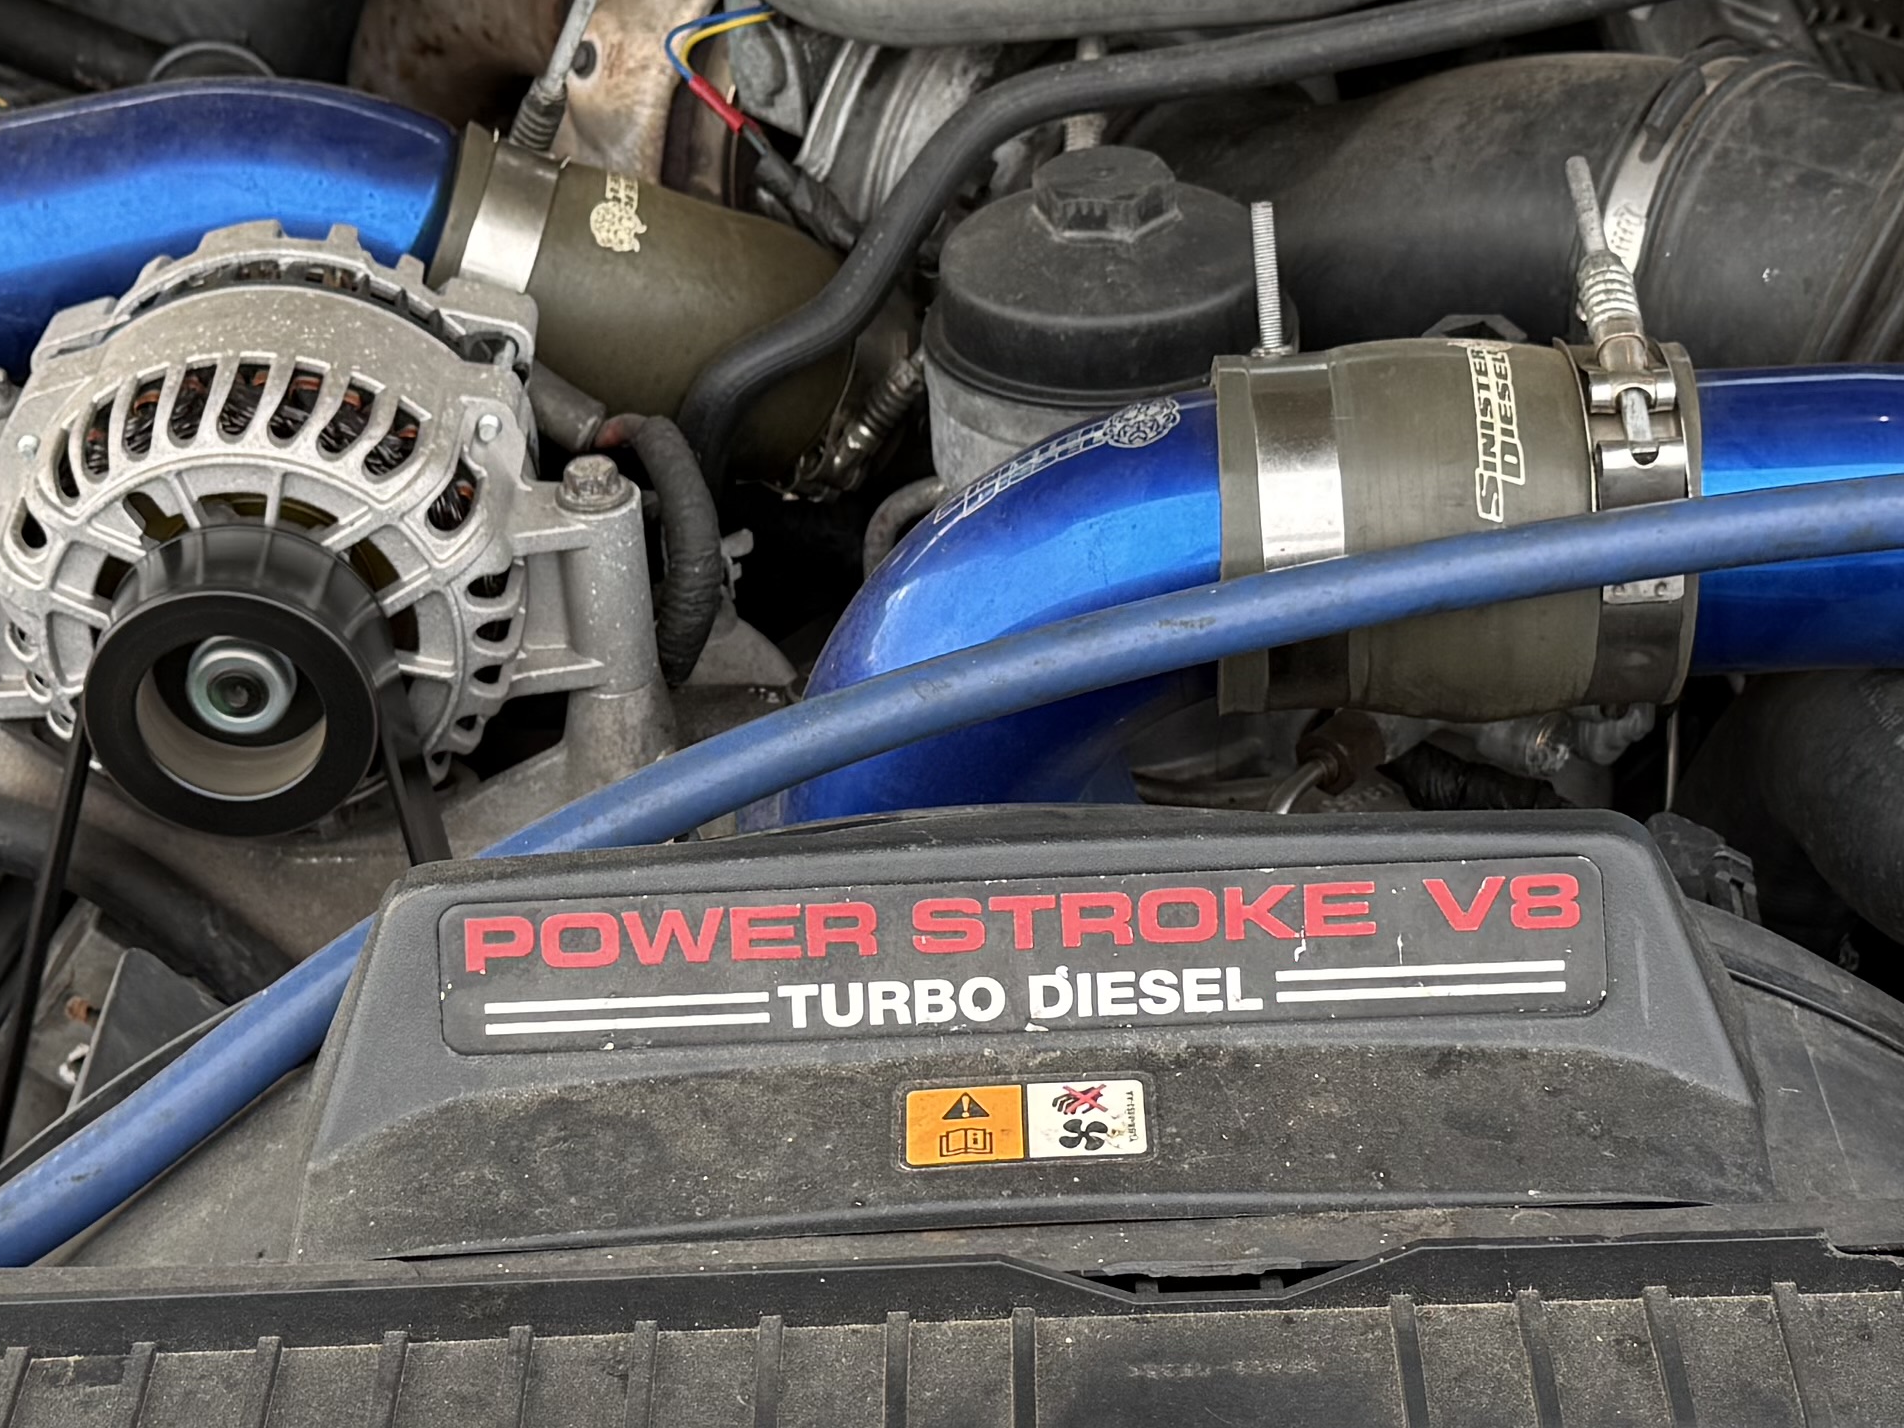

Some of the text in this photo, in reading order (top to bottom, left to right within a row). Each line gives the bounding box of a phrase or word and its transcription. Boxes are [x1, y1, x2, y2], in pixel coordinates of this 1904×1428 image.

[1467, 347, 1504, 523] SINISTER
[1489, 351, 1526, 486] DIESEL
[463, 871, 1582, 975] POWER STROKE V8
[776, 965, 1265, 1032] TURBO DIESEL
